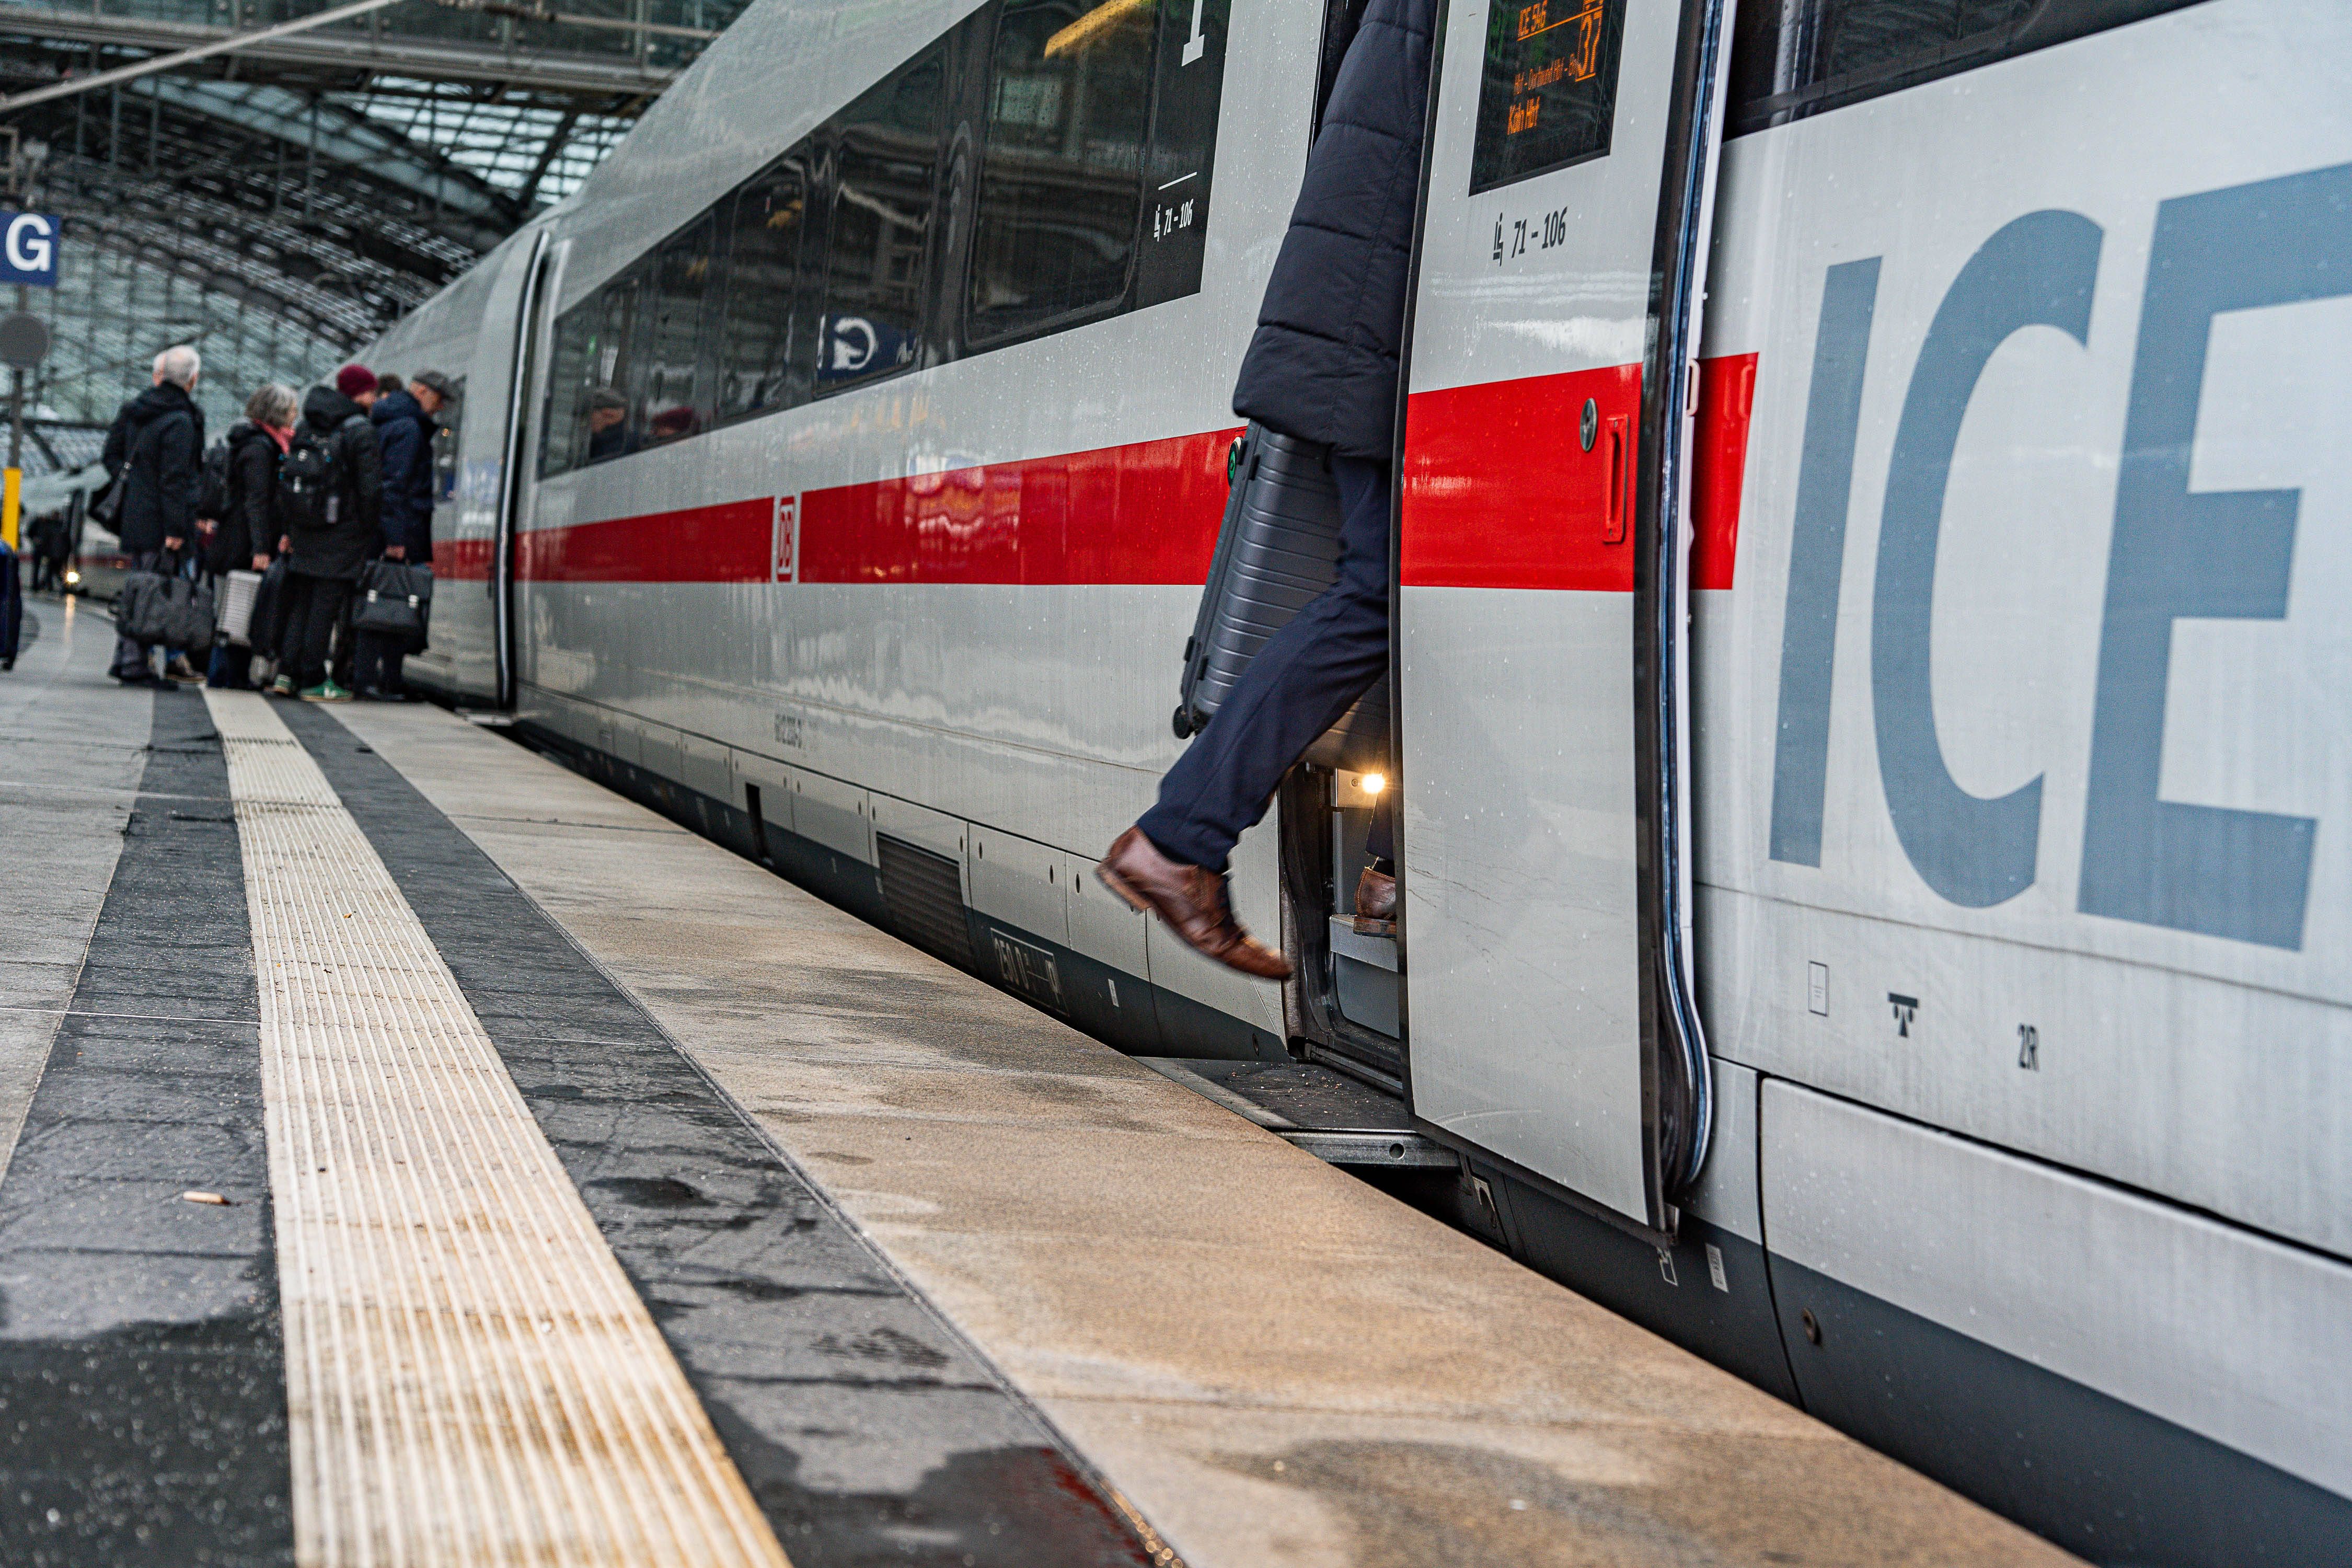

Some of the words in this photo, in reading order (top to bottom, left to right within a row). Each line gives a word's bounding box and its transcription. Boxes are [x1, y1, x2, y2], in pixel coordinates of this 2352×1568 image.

[1517, 6, 1531, 37] ICE
[1577, 9, 1604, 77] 37
[1525, 96, 1541, 130] Hbf
[6, 213, 51, 272] G
[1163, 208, 1173, 236] 71
[1179, 199, 1194, 228] 106
[1512, 218, 1527, 258] 71
[1542, 206, 1568, 249] 106
[1769, 163, 2352, 951] ICE
